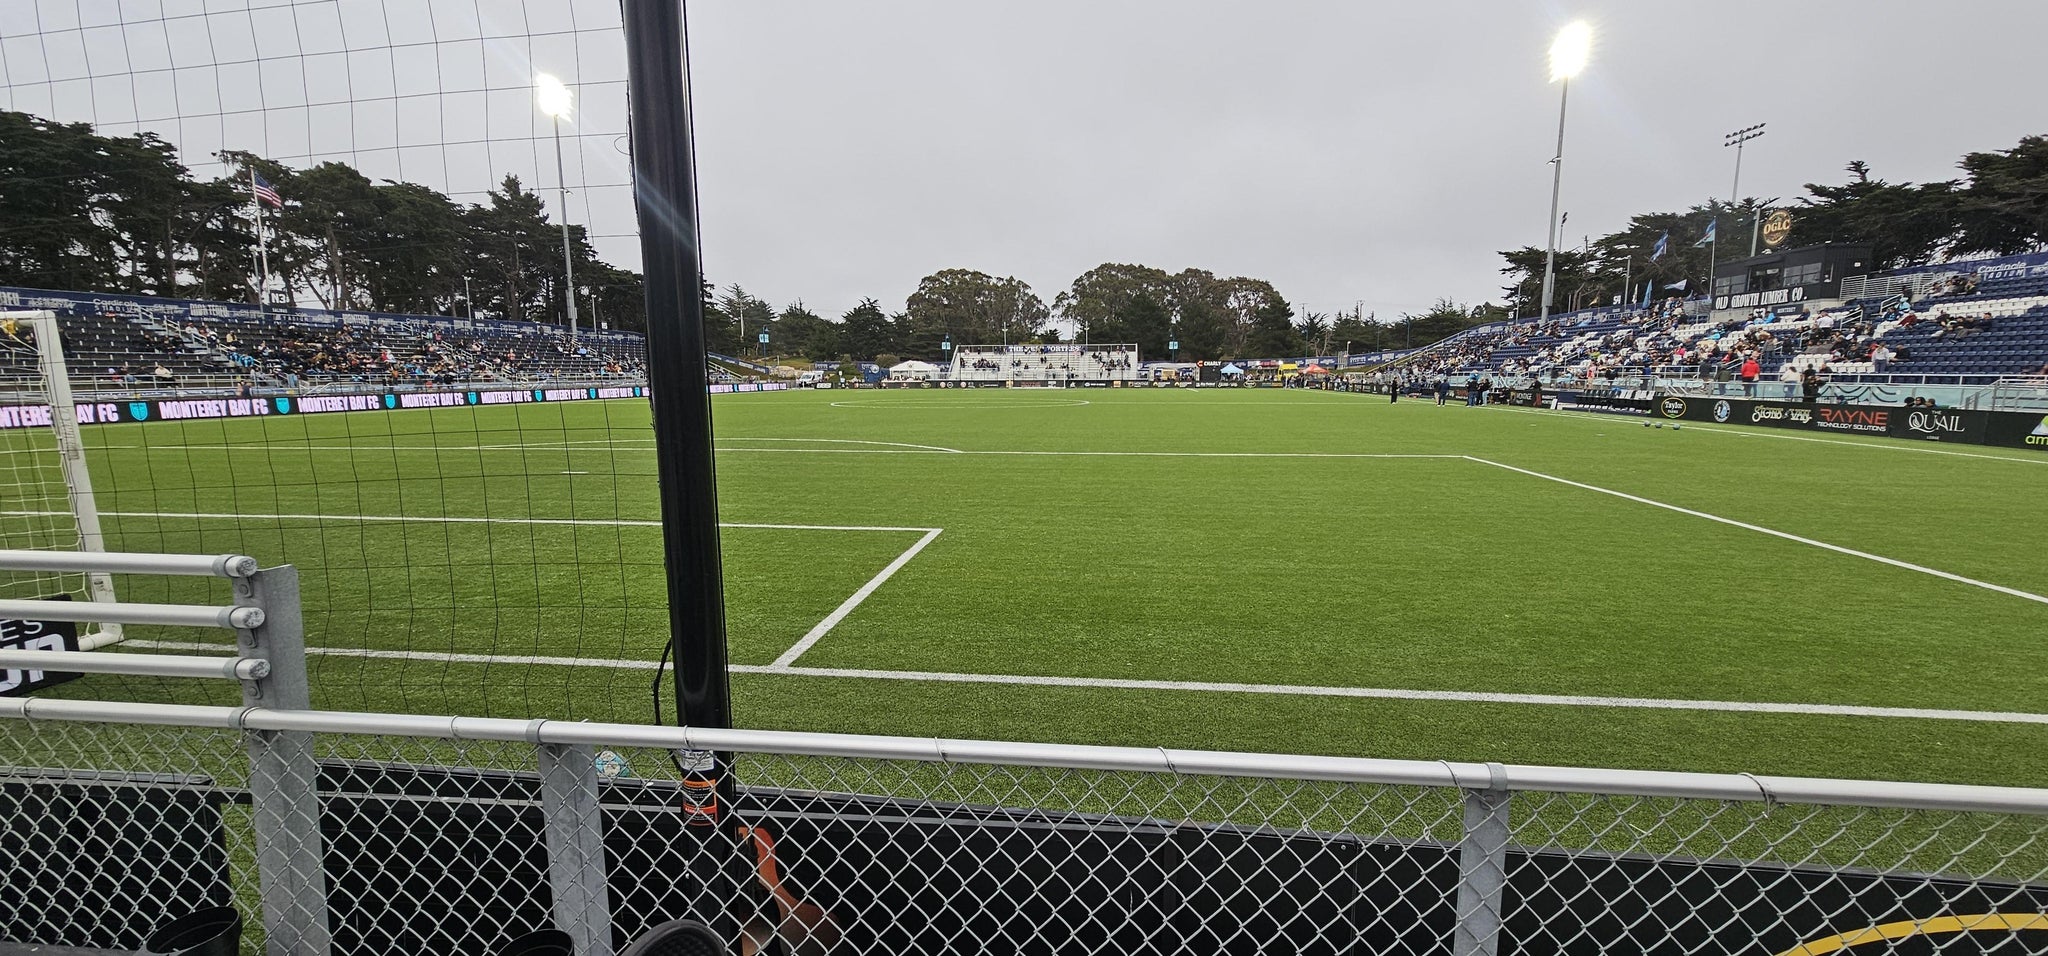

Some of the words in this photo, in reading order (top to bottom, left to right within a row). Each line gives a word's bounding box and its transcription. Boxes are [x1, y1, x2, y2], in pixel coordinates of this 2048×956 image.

[1763, 219, 1791, 235] OGLC
[1978, 261, 2026, 274] Cardinale
[271, 292, 286, 304] N3
[1715, 296, 1729, 310] OLD
[1731, 292, 1760, 308] GROWTH
[1761, 288, 1789, 305] LUMBER
[158, 400, 227, 419] MONTEREY
[228, 399, 252, 416] BAY
[252, 398, 269, 415] FC
[297, 396, 348, 413] MONTEREY
[350, 395, 367, 411] BAY
[367, 395, 380, 410] FC
[400, 393, 440, 408] MONTEREY
[1665, 401, 1683, 410] Taylor
[0, 405, 53, 428] NTERE
[76, 403, 95, 424] AY
[97, 403, 119, 422] FC
[1820, 408, 1889, 426] RAYNE
[1908, 411, 1965, 433] QUAIL
[1817, 421, 1852, 429] TECHNOLOGY
[1853, 423, 1887, 432] SOLUTIONS
